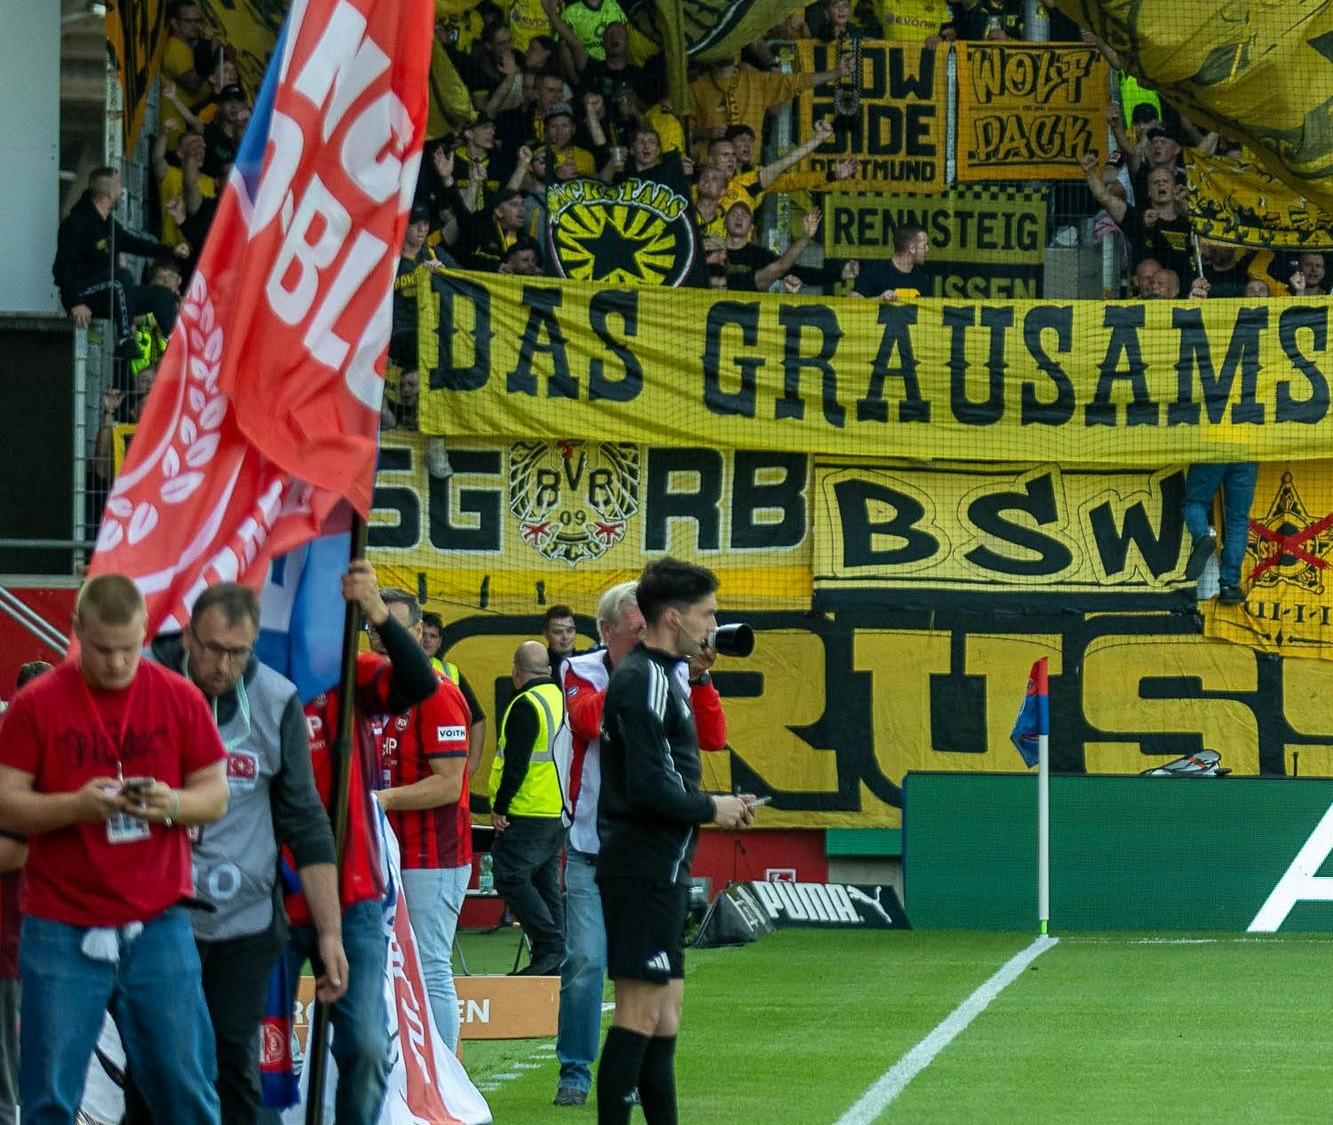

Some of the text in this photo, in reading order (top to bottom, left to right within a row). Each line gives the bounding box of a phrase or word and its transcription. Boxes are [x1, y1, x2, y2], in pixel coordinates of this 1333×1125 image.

[429, 273, 644, 402] DAS
[643, 448, 811, 555] RB
[752, 881, 860, 923] PUMA
